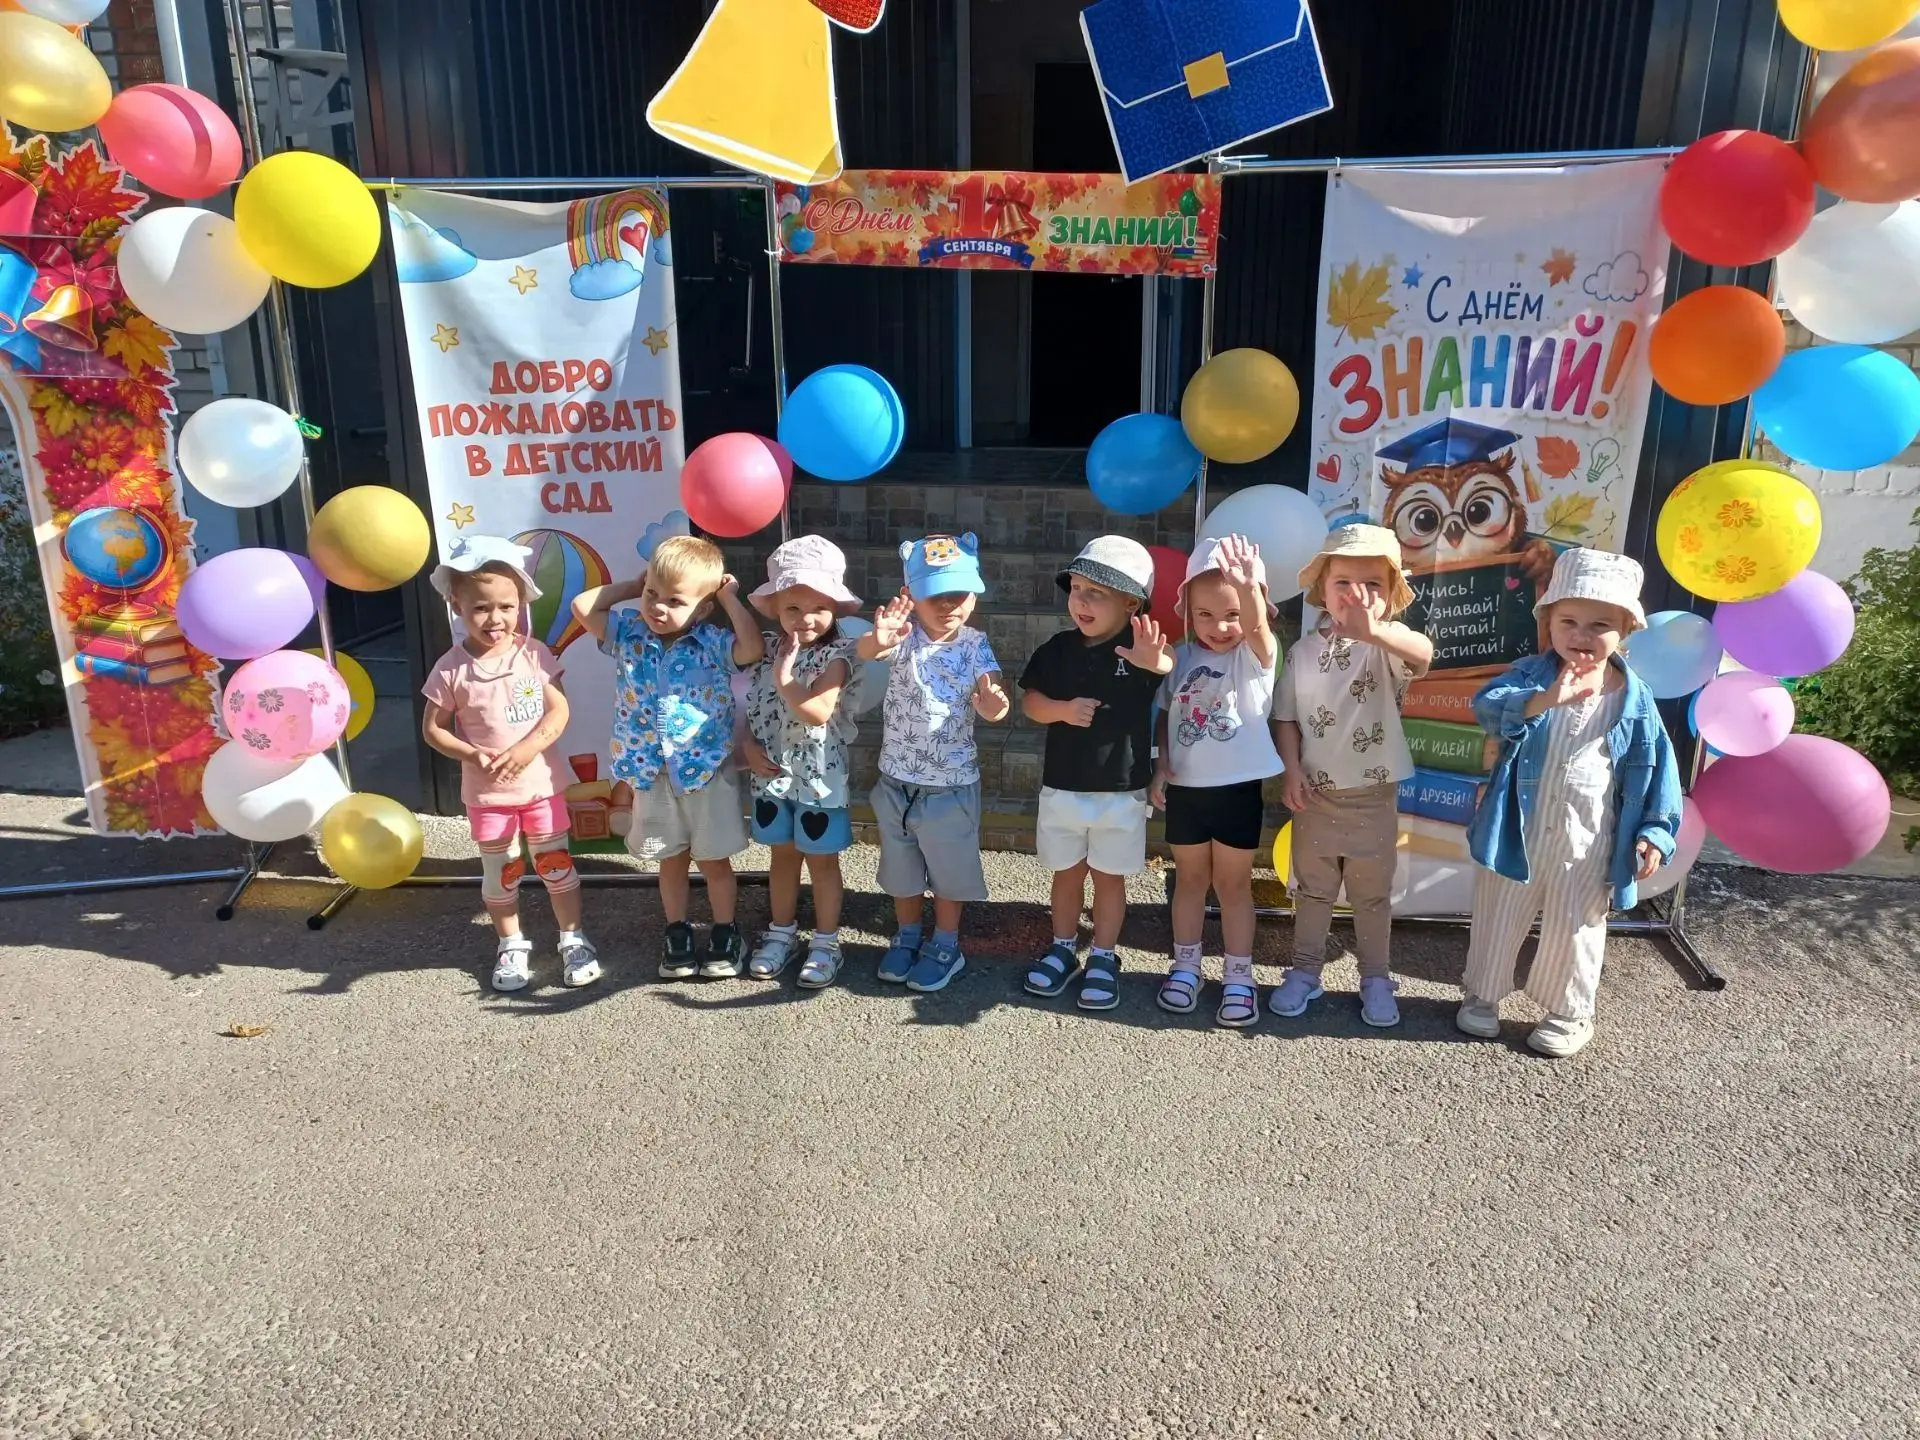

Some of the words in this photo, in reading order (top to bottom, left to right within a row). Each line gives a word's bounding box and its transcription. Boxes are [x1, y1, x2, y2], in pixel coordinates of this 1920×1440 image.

[804, 197, 830, 231] С
[829, 198, 915, 235] Днём
[1048, 211, 1198, 248] ЗНАНИЙ!
[948, 174, 991, 238] 1
[943, 240, 1012, 256] СЕНТЯБРЯ
[1426, 275, 1452, 323] С
[489, 359, 613, 395] ДОБРО
[1329, 314, 1637, 434] ЗНАНИЙ!
[428, 399, 676, 437] ПОЖАЛОВАТЬ
[464, 444, 492, 476] В
[503, 436, 663, 476] ДЕТСКИЙ
[540, 481, 613, 514] САД
[1413, 576, 1475, 602] Учись!
[1422, 594, 1500, 621] Узнавай!
[1424, 616, 1496, 640] Мечтай!
[1114, 658, 1129, 676] A
[1432, 739, 1471, 758] ИДЕЙ!
[1418, 787, 1466, 808] ДРУЗЕЙ!
